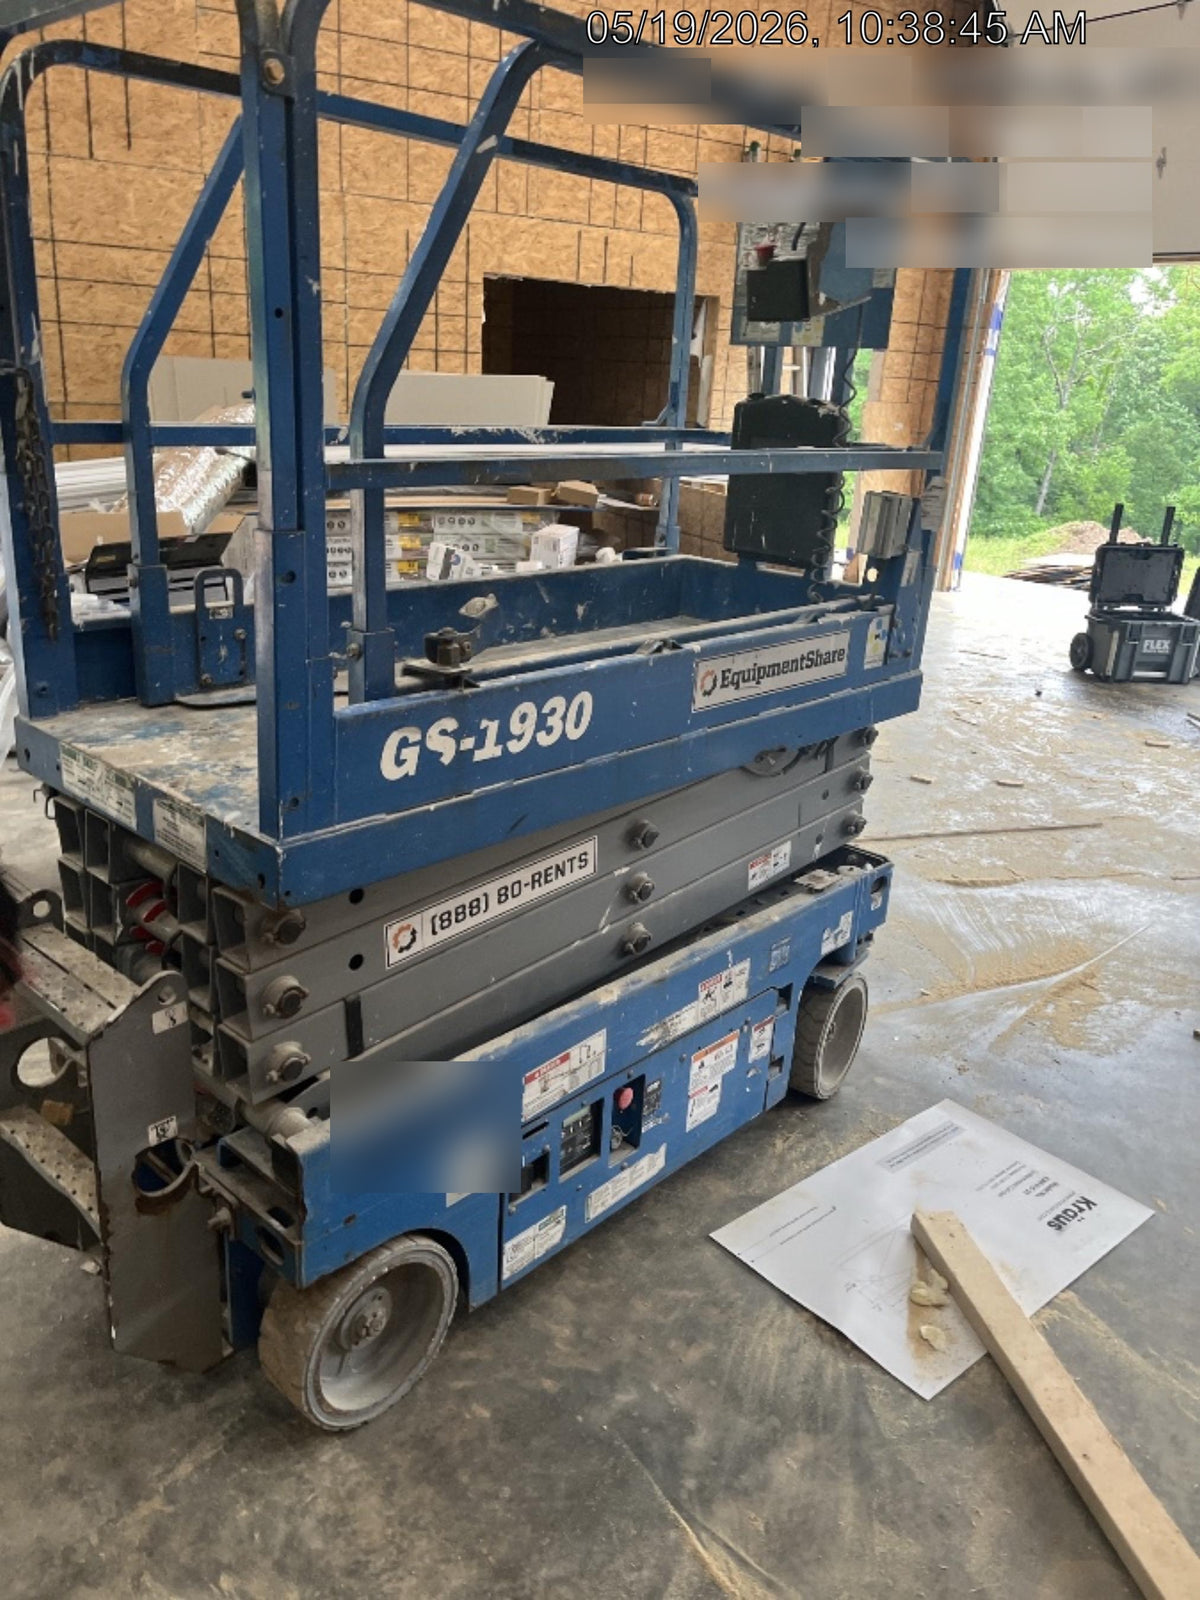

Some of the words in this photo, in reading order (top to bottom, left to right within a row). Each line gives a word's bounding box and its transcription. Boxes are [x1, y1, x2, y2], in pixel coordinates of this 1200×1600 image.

[720, 648, 846, 690] EquipmentShare
[1142, 639, 1171, 653] FLEX
[379, 691, 593, 781] GS-1930
[430, 892, 490, 936] (888)
[496, 851, 590, 905] 80-RENTS
